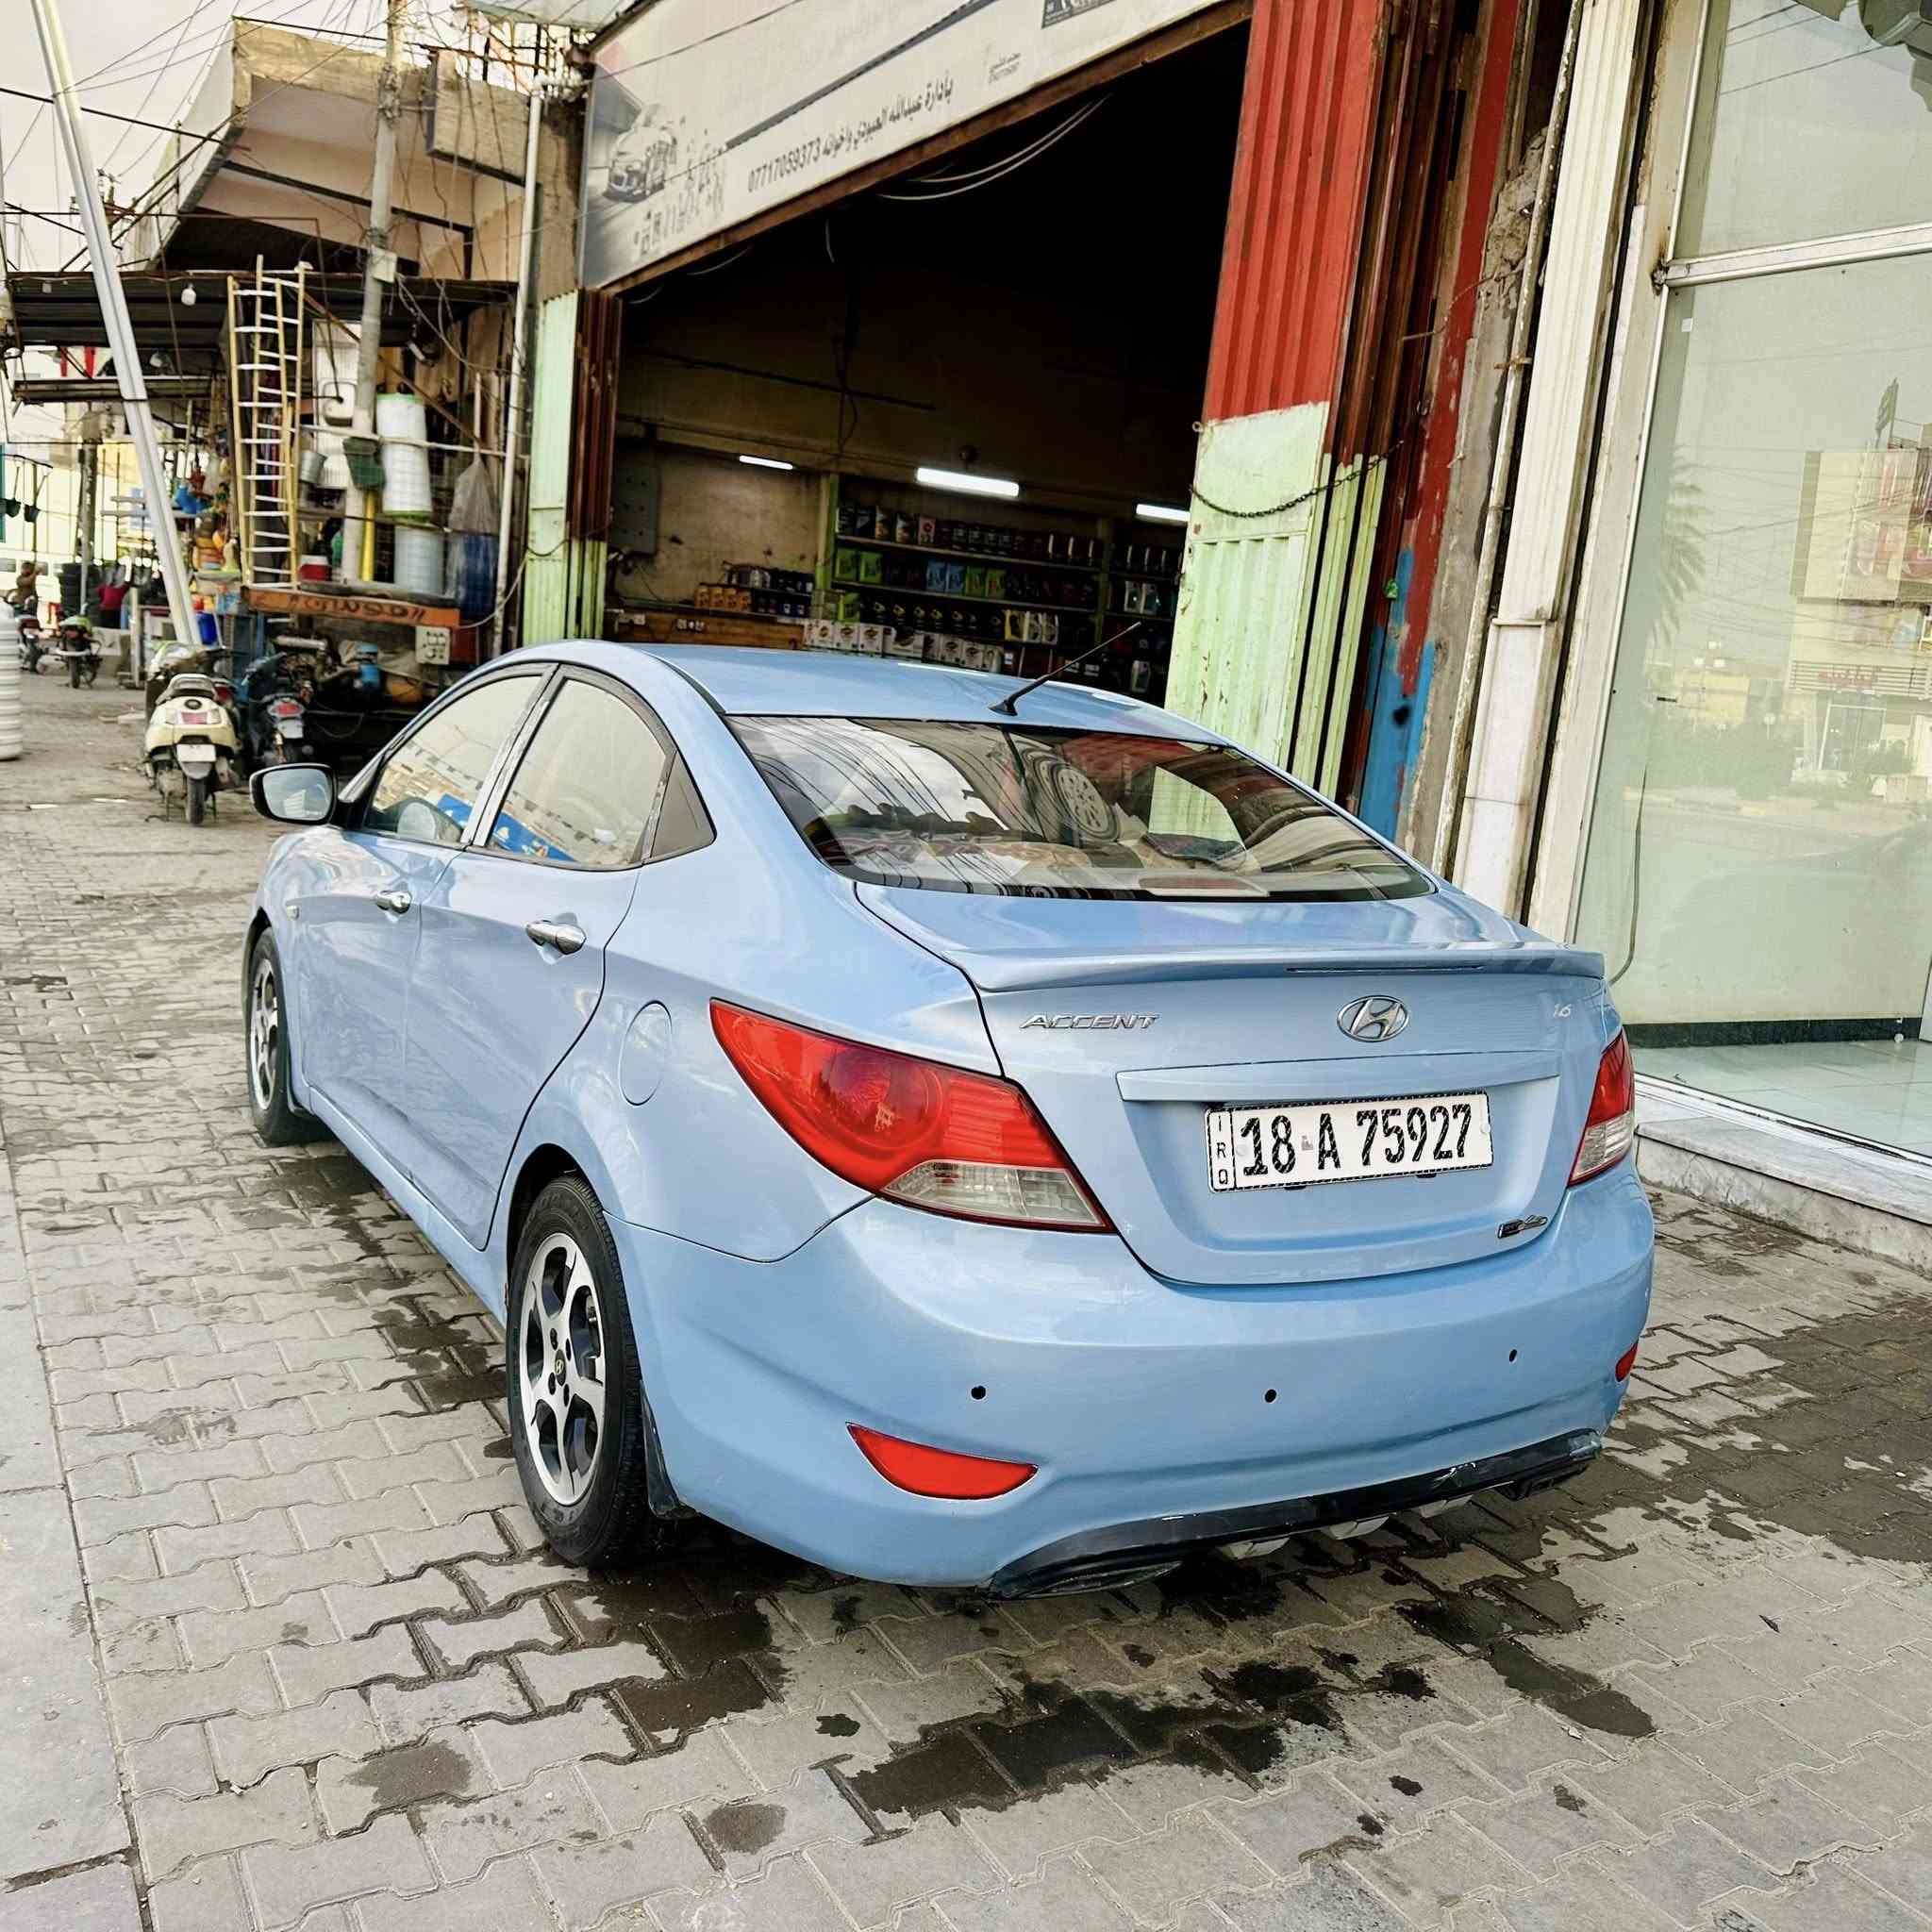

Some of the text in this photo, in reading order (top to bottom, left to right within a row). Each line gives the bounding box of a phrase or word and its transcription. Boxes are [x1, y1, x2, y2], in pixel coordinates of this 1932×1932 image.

[1019, 1014, 1159, 1029] ACCENT
[1241, 1103, 1472, 1176] 18 A 75927
